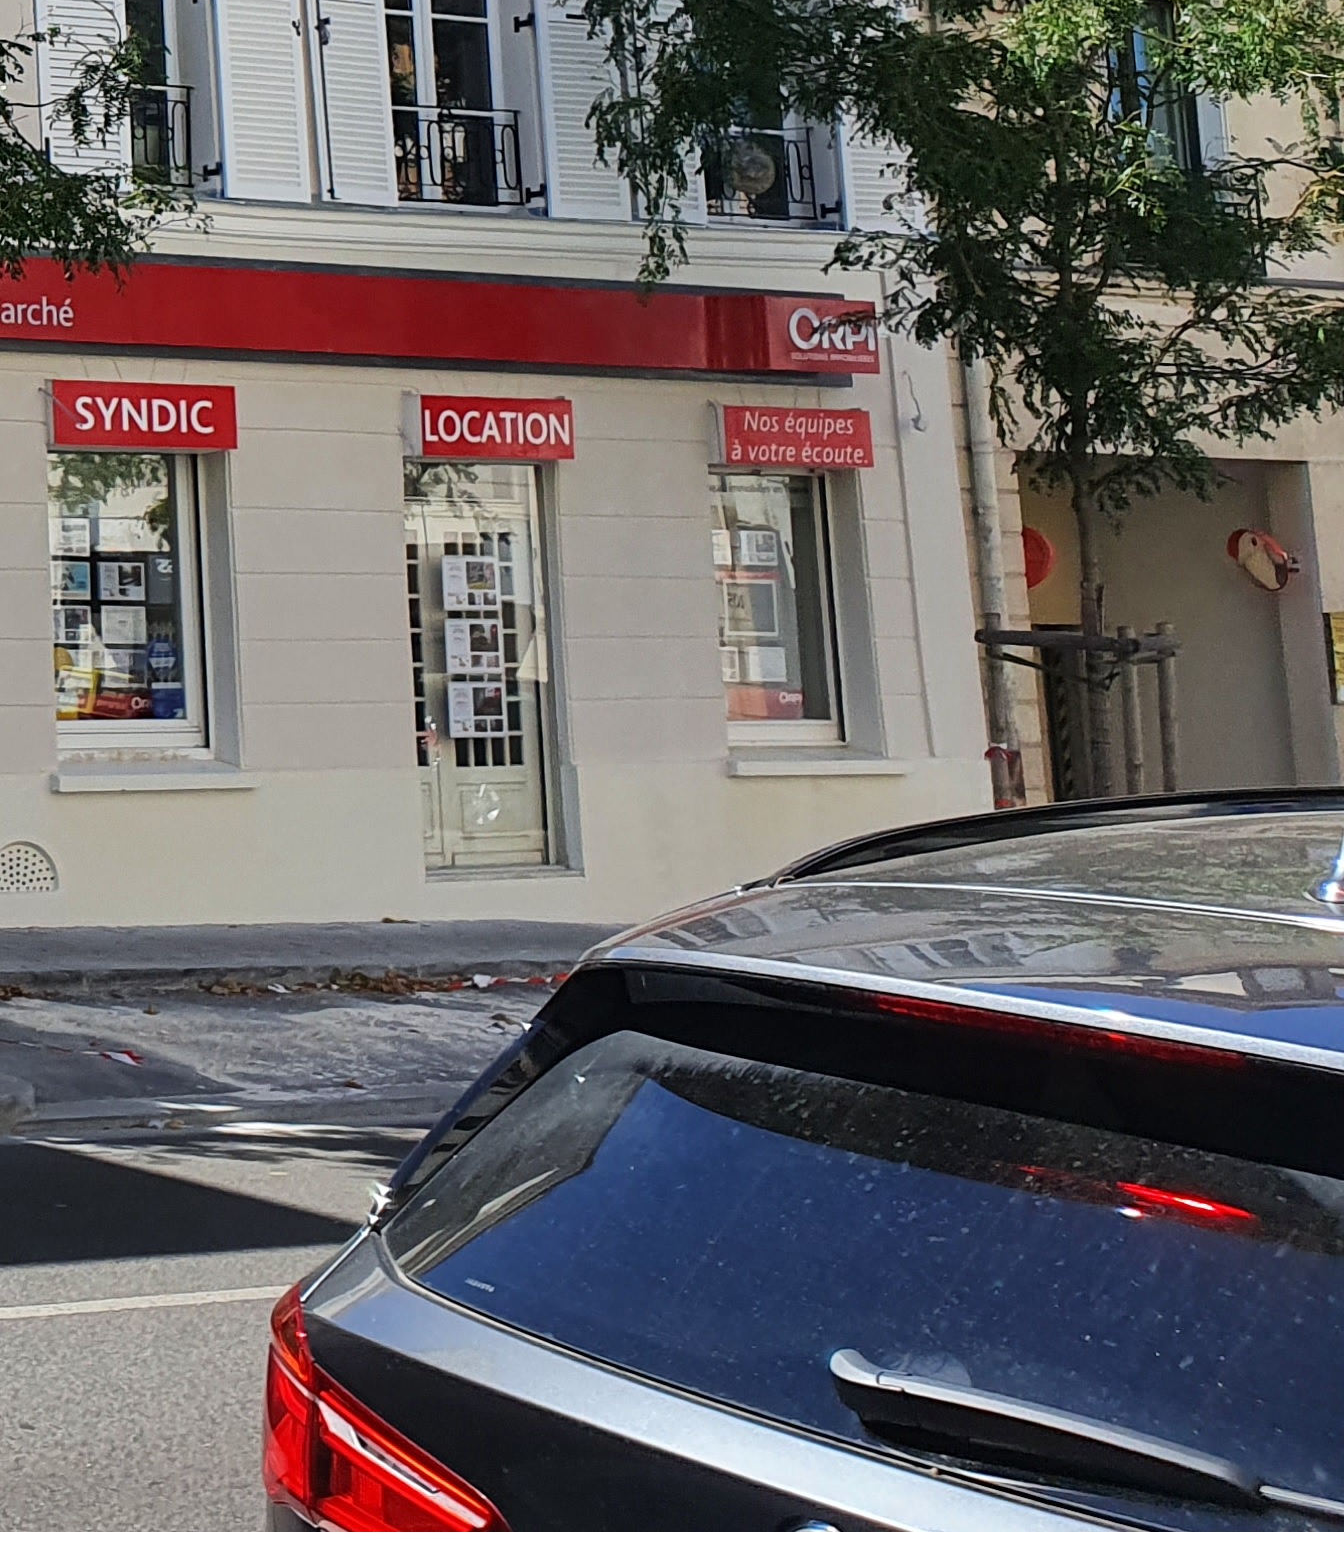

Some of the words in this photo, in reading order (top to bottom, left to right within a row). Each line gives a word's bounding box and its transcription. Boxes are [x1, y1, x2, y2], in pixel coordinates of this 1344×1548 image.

[76, 397, 213, 433] SYNDIC
[425, 411, 569, 444] LOCATION
[743, 413, 781, 433] Nos
[785, 412, 855, 439] équipes
[732, 439, 743, 462] à
[747, 444, 796, 462] votre
[802, 441, 869, 464] écoute.
